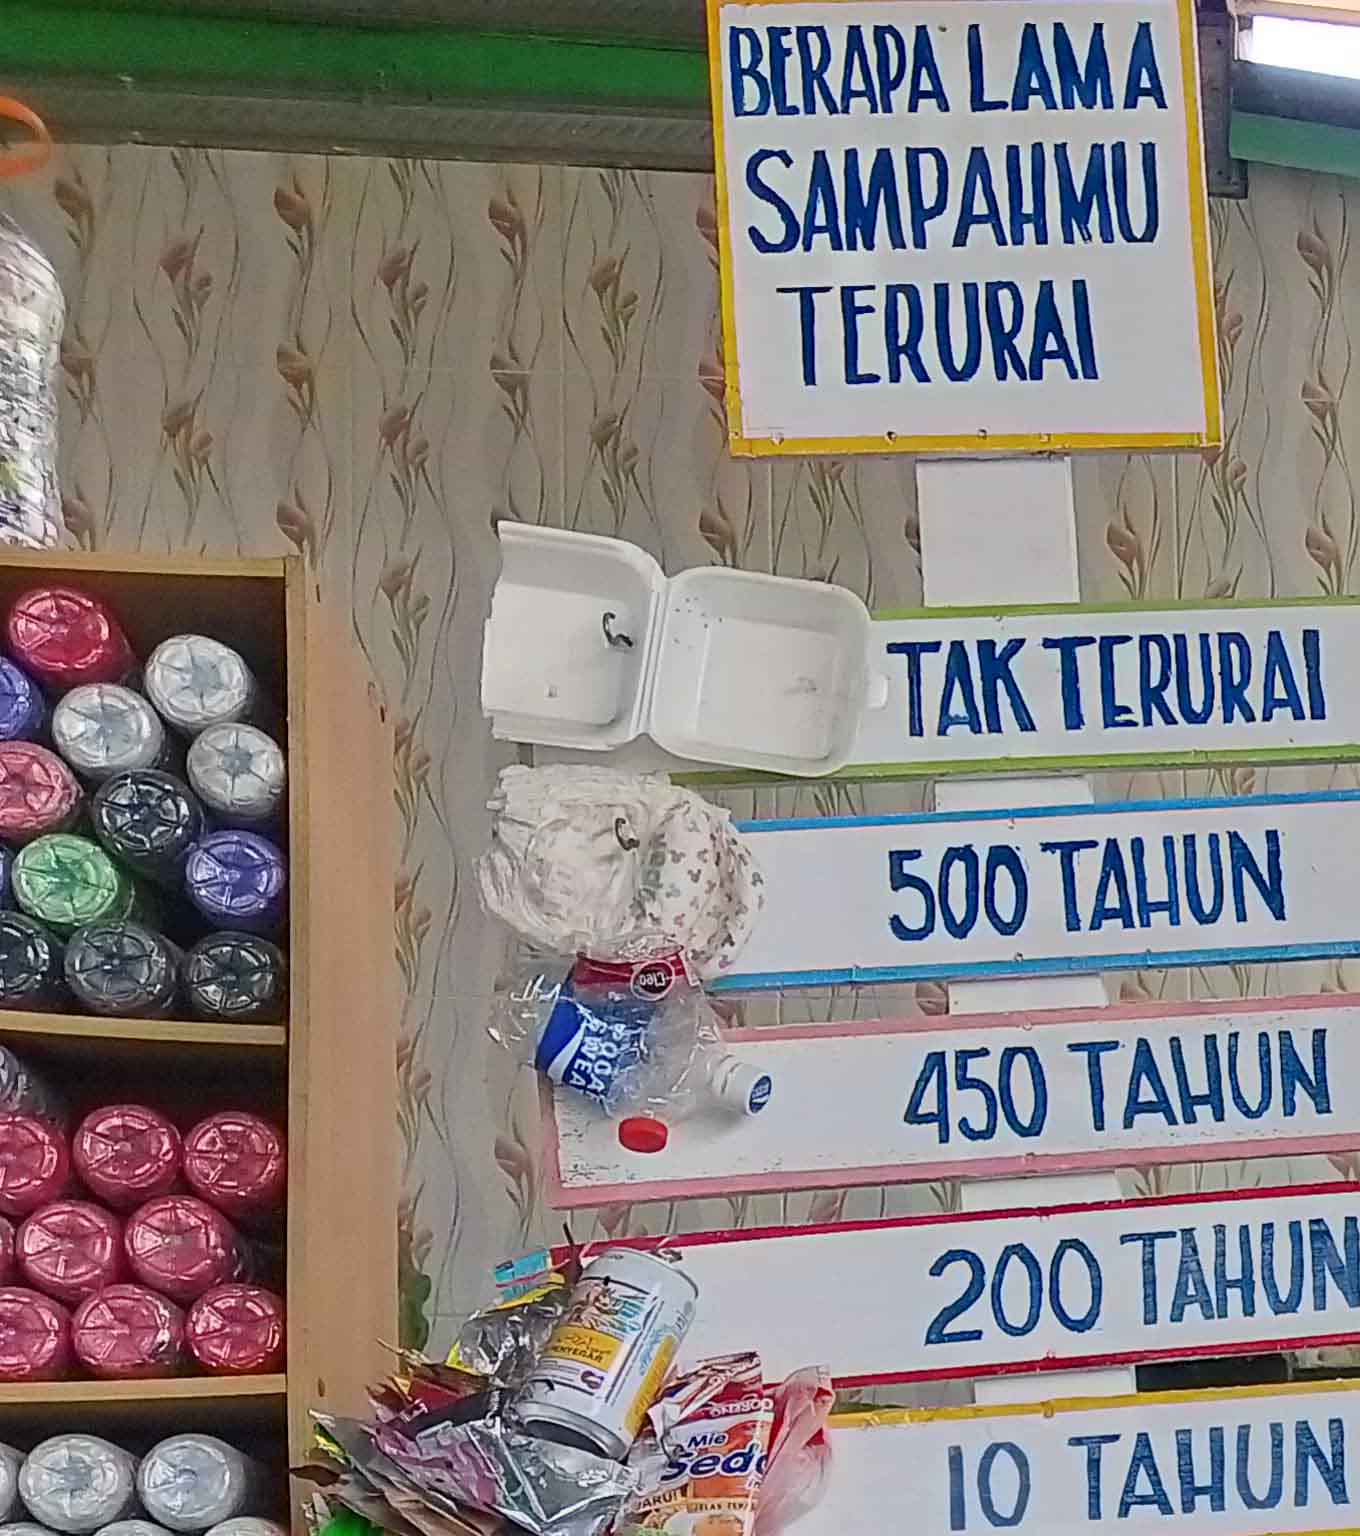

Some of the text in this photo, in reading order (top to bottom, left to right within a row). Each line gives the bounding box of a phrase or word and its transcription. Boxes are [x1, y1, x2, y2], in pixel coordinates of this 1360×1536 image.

[728, 20, 1169, 118] BERAPA LAMA
[744, 140, 1160, 255] SAMPAHMU
[776, 280, 1100, 387] TERURAI
[886, 628, 1327, 738] TAK TERURAI
[887, 828, 1288, 944] 500 TAHUN
[903, 1027, 1331, 1147] 450 TAHUN
[923, 1236, 1104, 1347] 200
[687, 1431, 728, 1449] Mie
[947, 1417, 1351, 1532] 10 TAHUN
